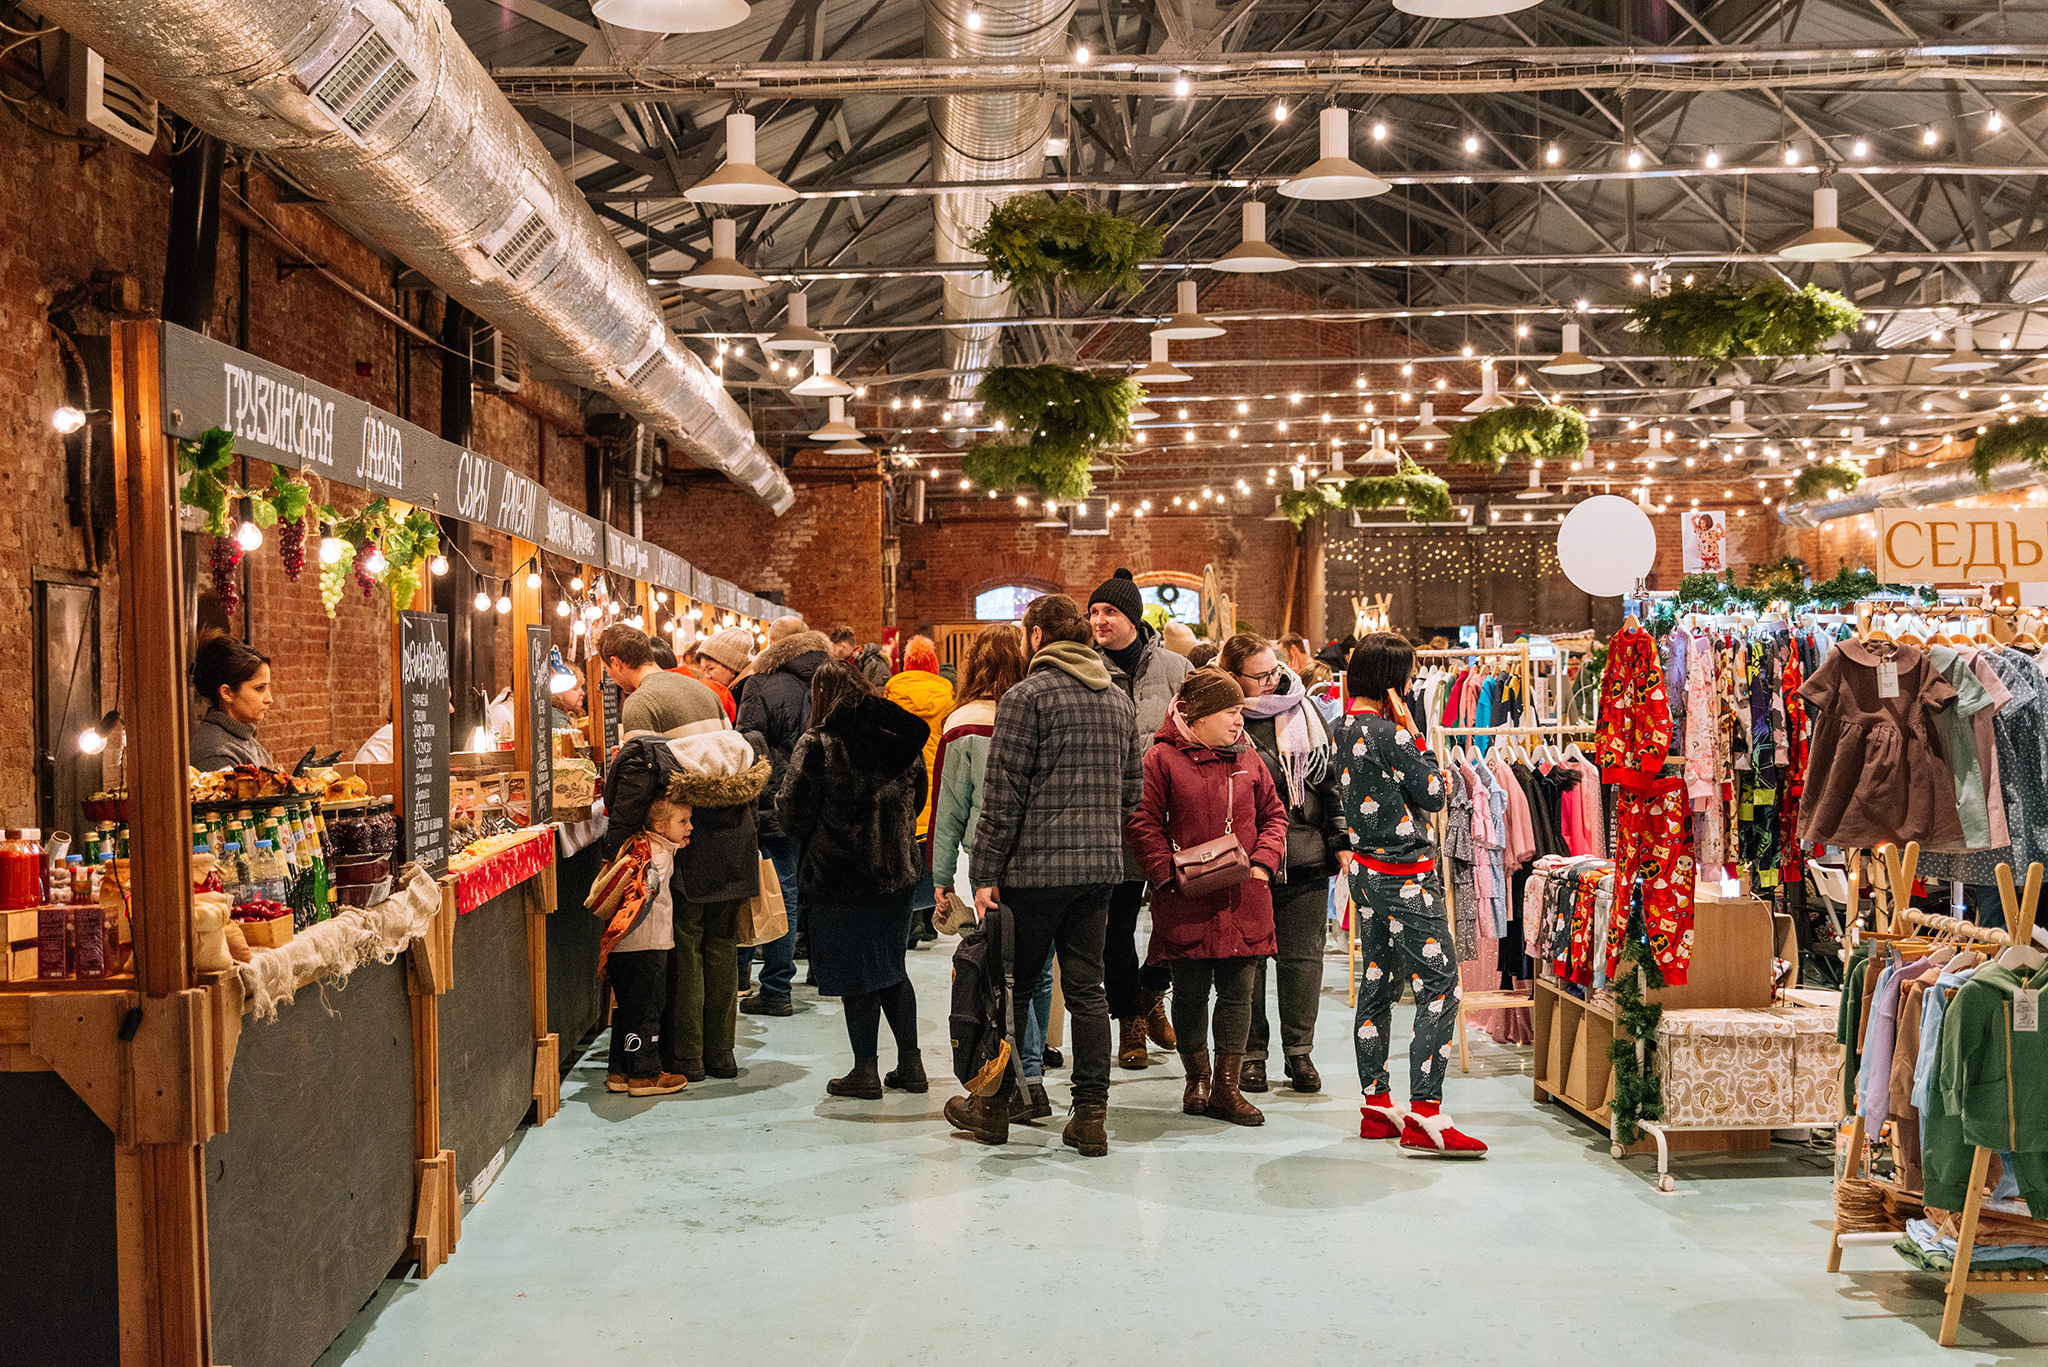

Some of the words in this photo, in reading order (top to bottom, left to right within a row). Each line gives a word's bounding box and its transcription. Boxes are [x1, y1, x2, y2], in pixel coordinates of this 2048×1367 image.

[224, 363, 335, 466] ГРУЗИНСКАЯ
[357, 417, 402, 489] ЛАВКА
[457, 452, 492, 523] СЫРЫ
[497, 470, 537, 540] АРМЕНИИ
[1885, 520, 2048, 579] СЕДЬ
